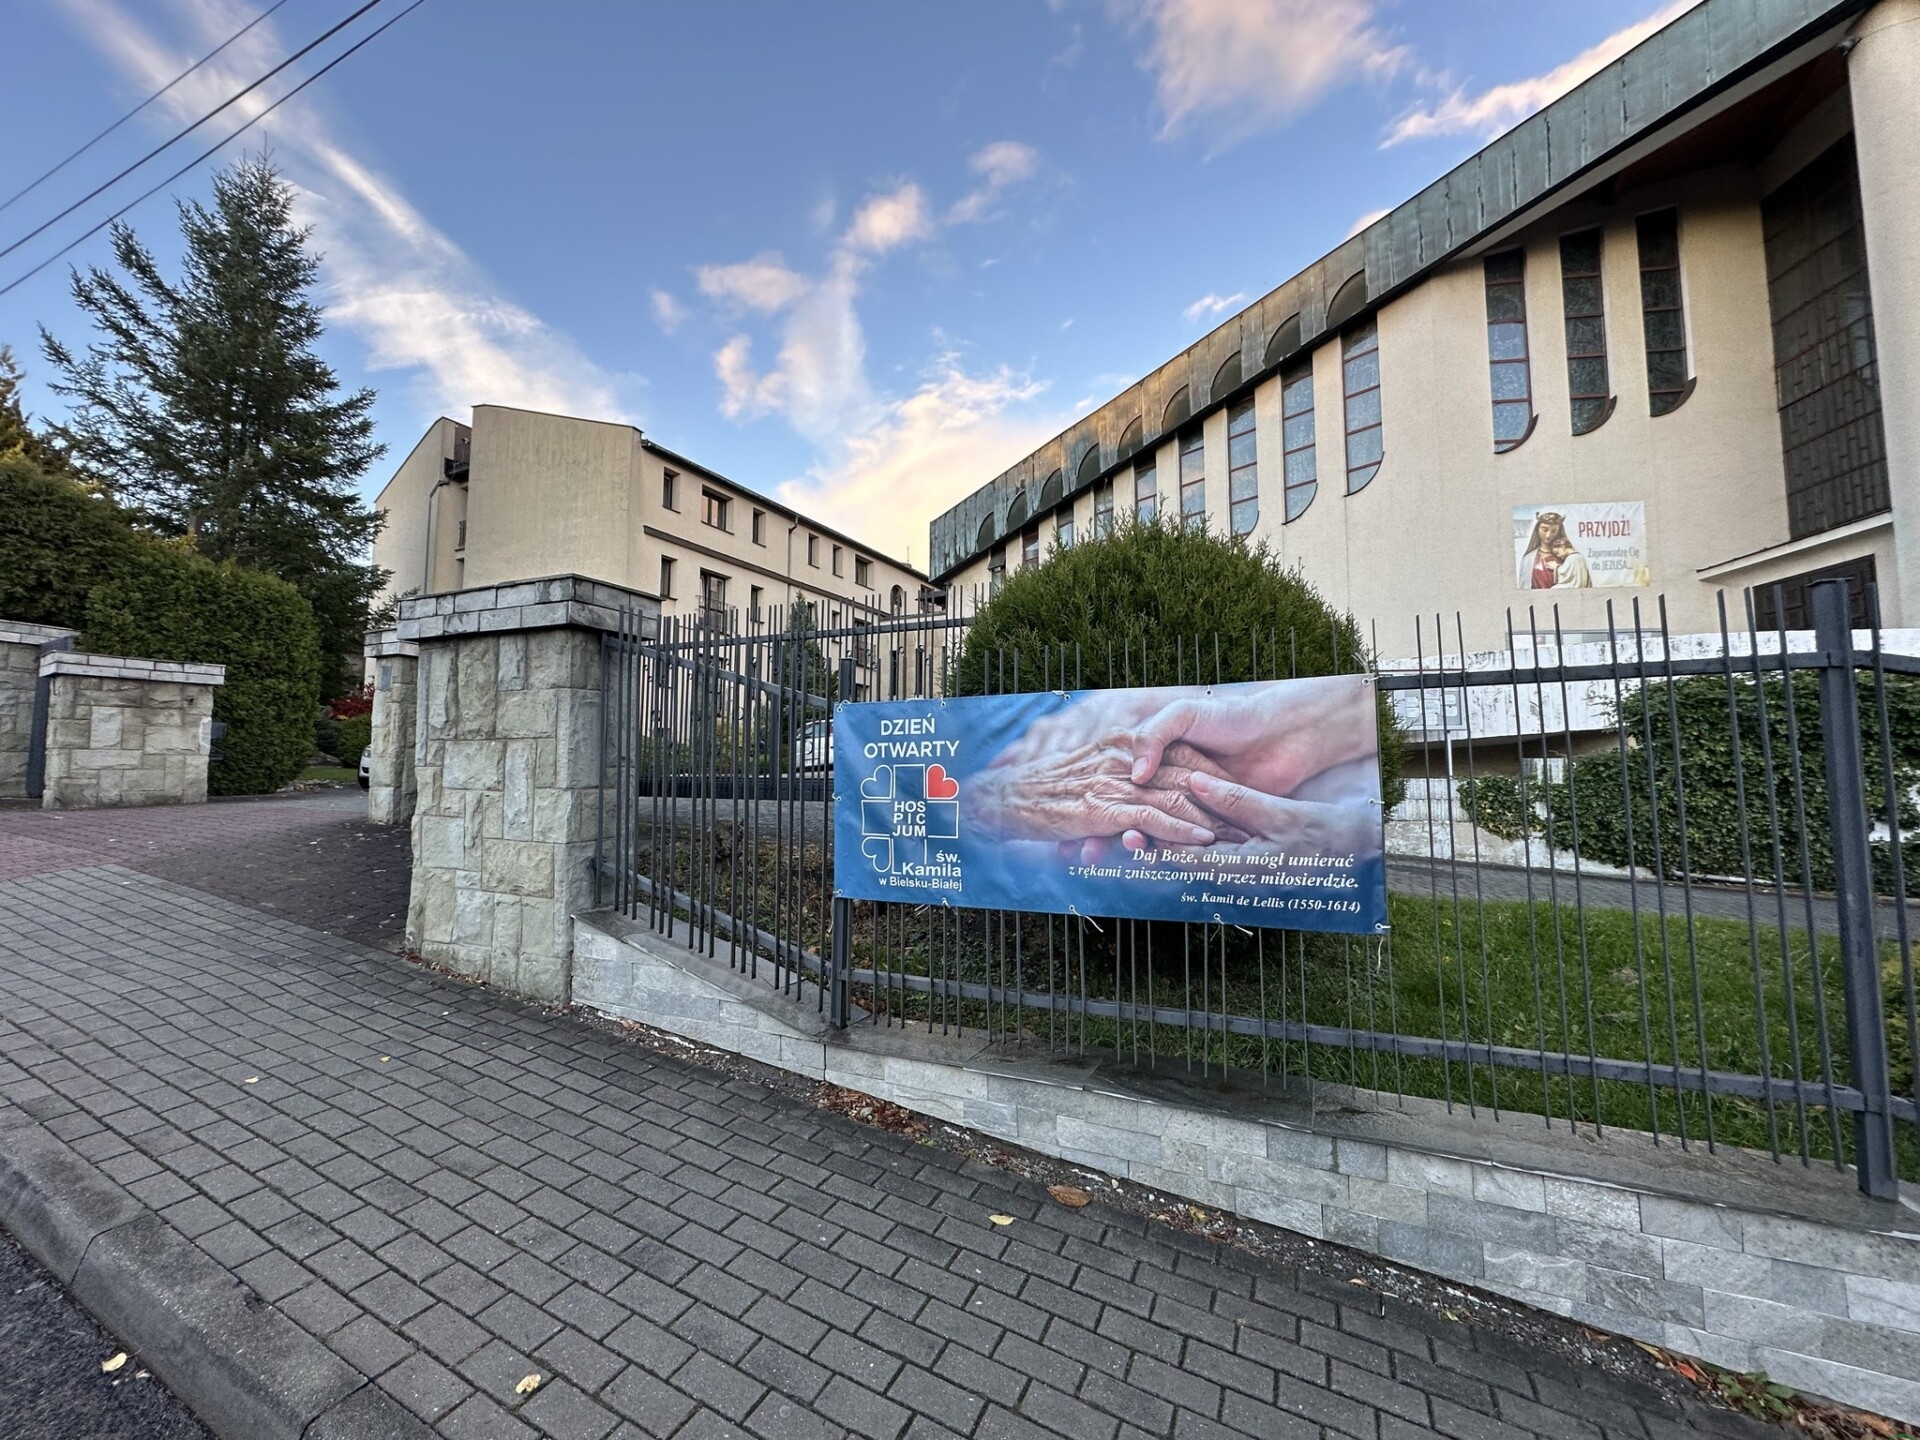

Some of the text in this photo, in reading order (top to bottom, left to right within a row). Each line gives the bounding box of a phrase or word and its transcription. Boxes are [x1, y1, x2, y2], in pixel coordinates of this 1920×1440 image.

[1578, 514, 1630, 538] PRZYJDŹ!
[1588, 546, 1640, 560] Zaprowadzę Cię
[1591, 560, 1601, 570] do
[880, 712, 935, 736] DZIEŃ
[863, 740, 960, 759] OTWARTY
[894, 801, 926, 813] HOS
[892, 825, 926, 837] JUM
[935, 850, 961, 863] św.
[1132, 847, 1354, 869] Daj Boże, abym mógł umierać
[902, 862, 961, 877] Kamila
[1068, 864, 1359, 889] z rękami zniszczonymi przez miłosierdzie.
[878, 876, 962, 892] w Bielsku-Białej
[1180, 892, 1361, 914] św. Kamil de Lellis (1550-1614)
